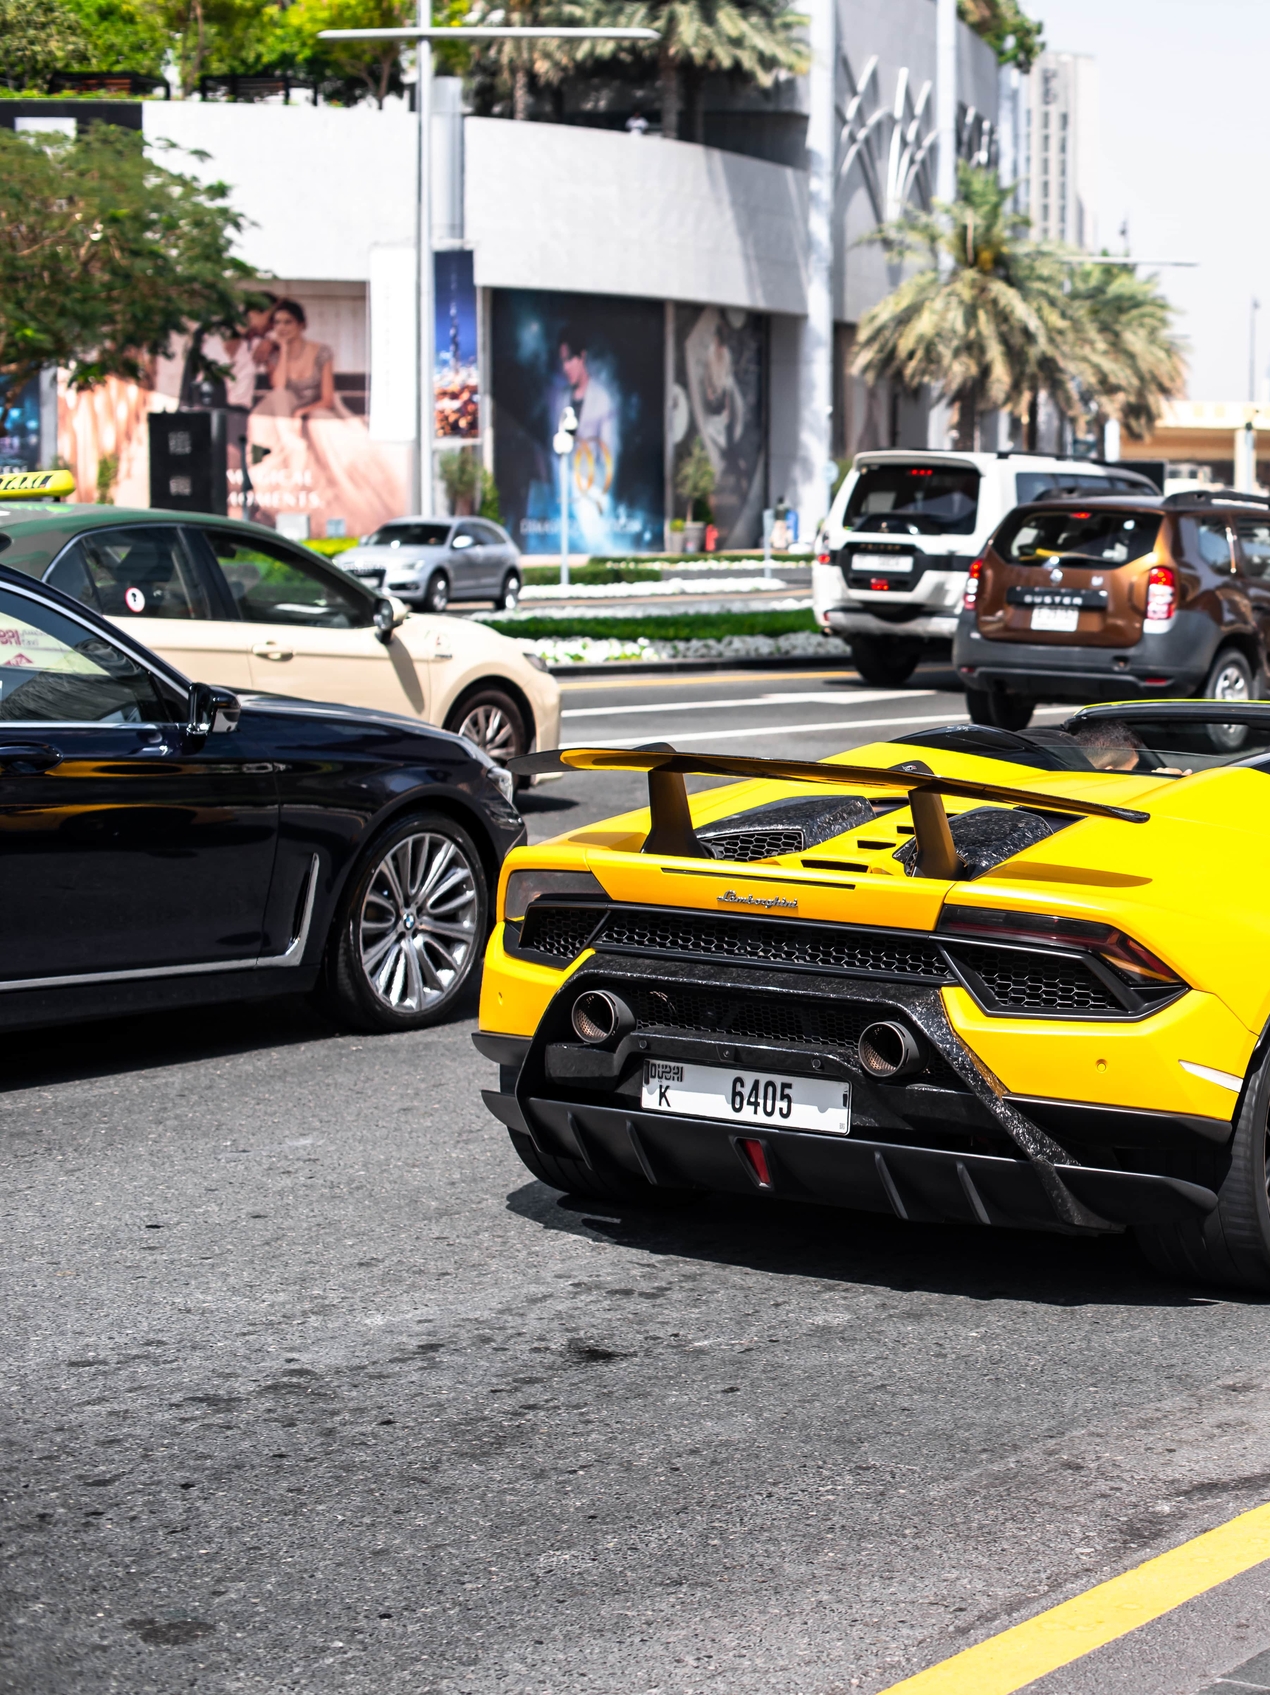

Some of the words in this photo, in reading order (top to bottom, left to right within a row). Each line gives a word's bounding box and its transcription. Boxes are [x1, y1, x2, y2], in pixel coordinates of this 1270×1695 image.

[717, 889, 799, 909] Lamborghini
[658, 1084, 671, 1108] K
[731, 1076, 793, 1119] 6405
